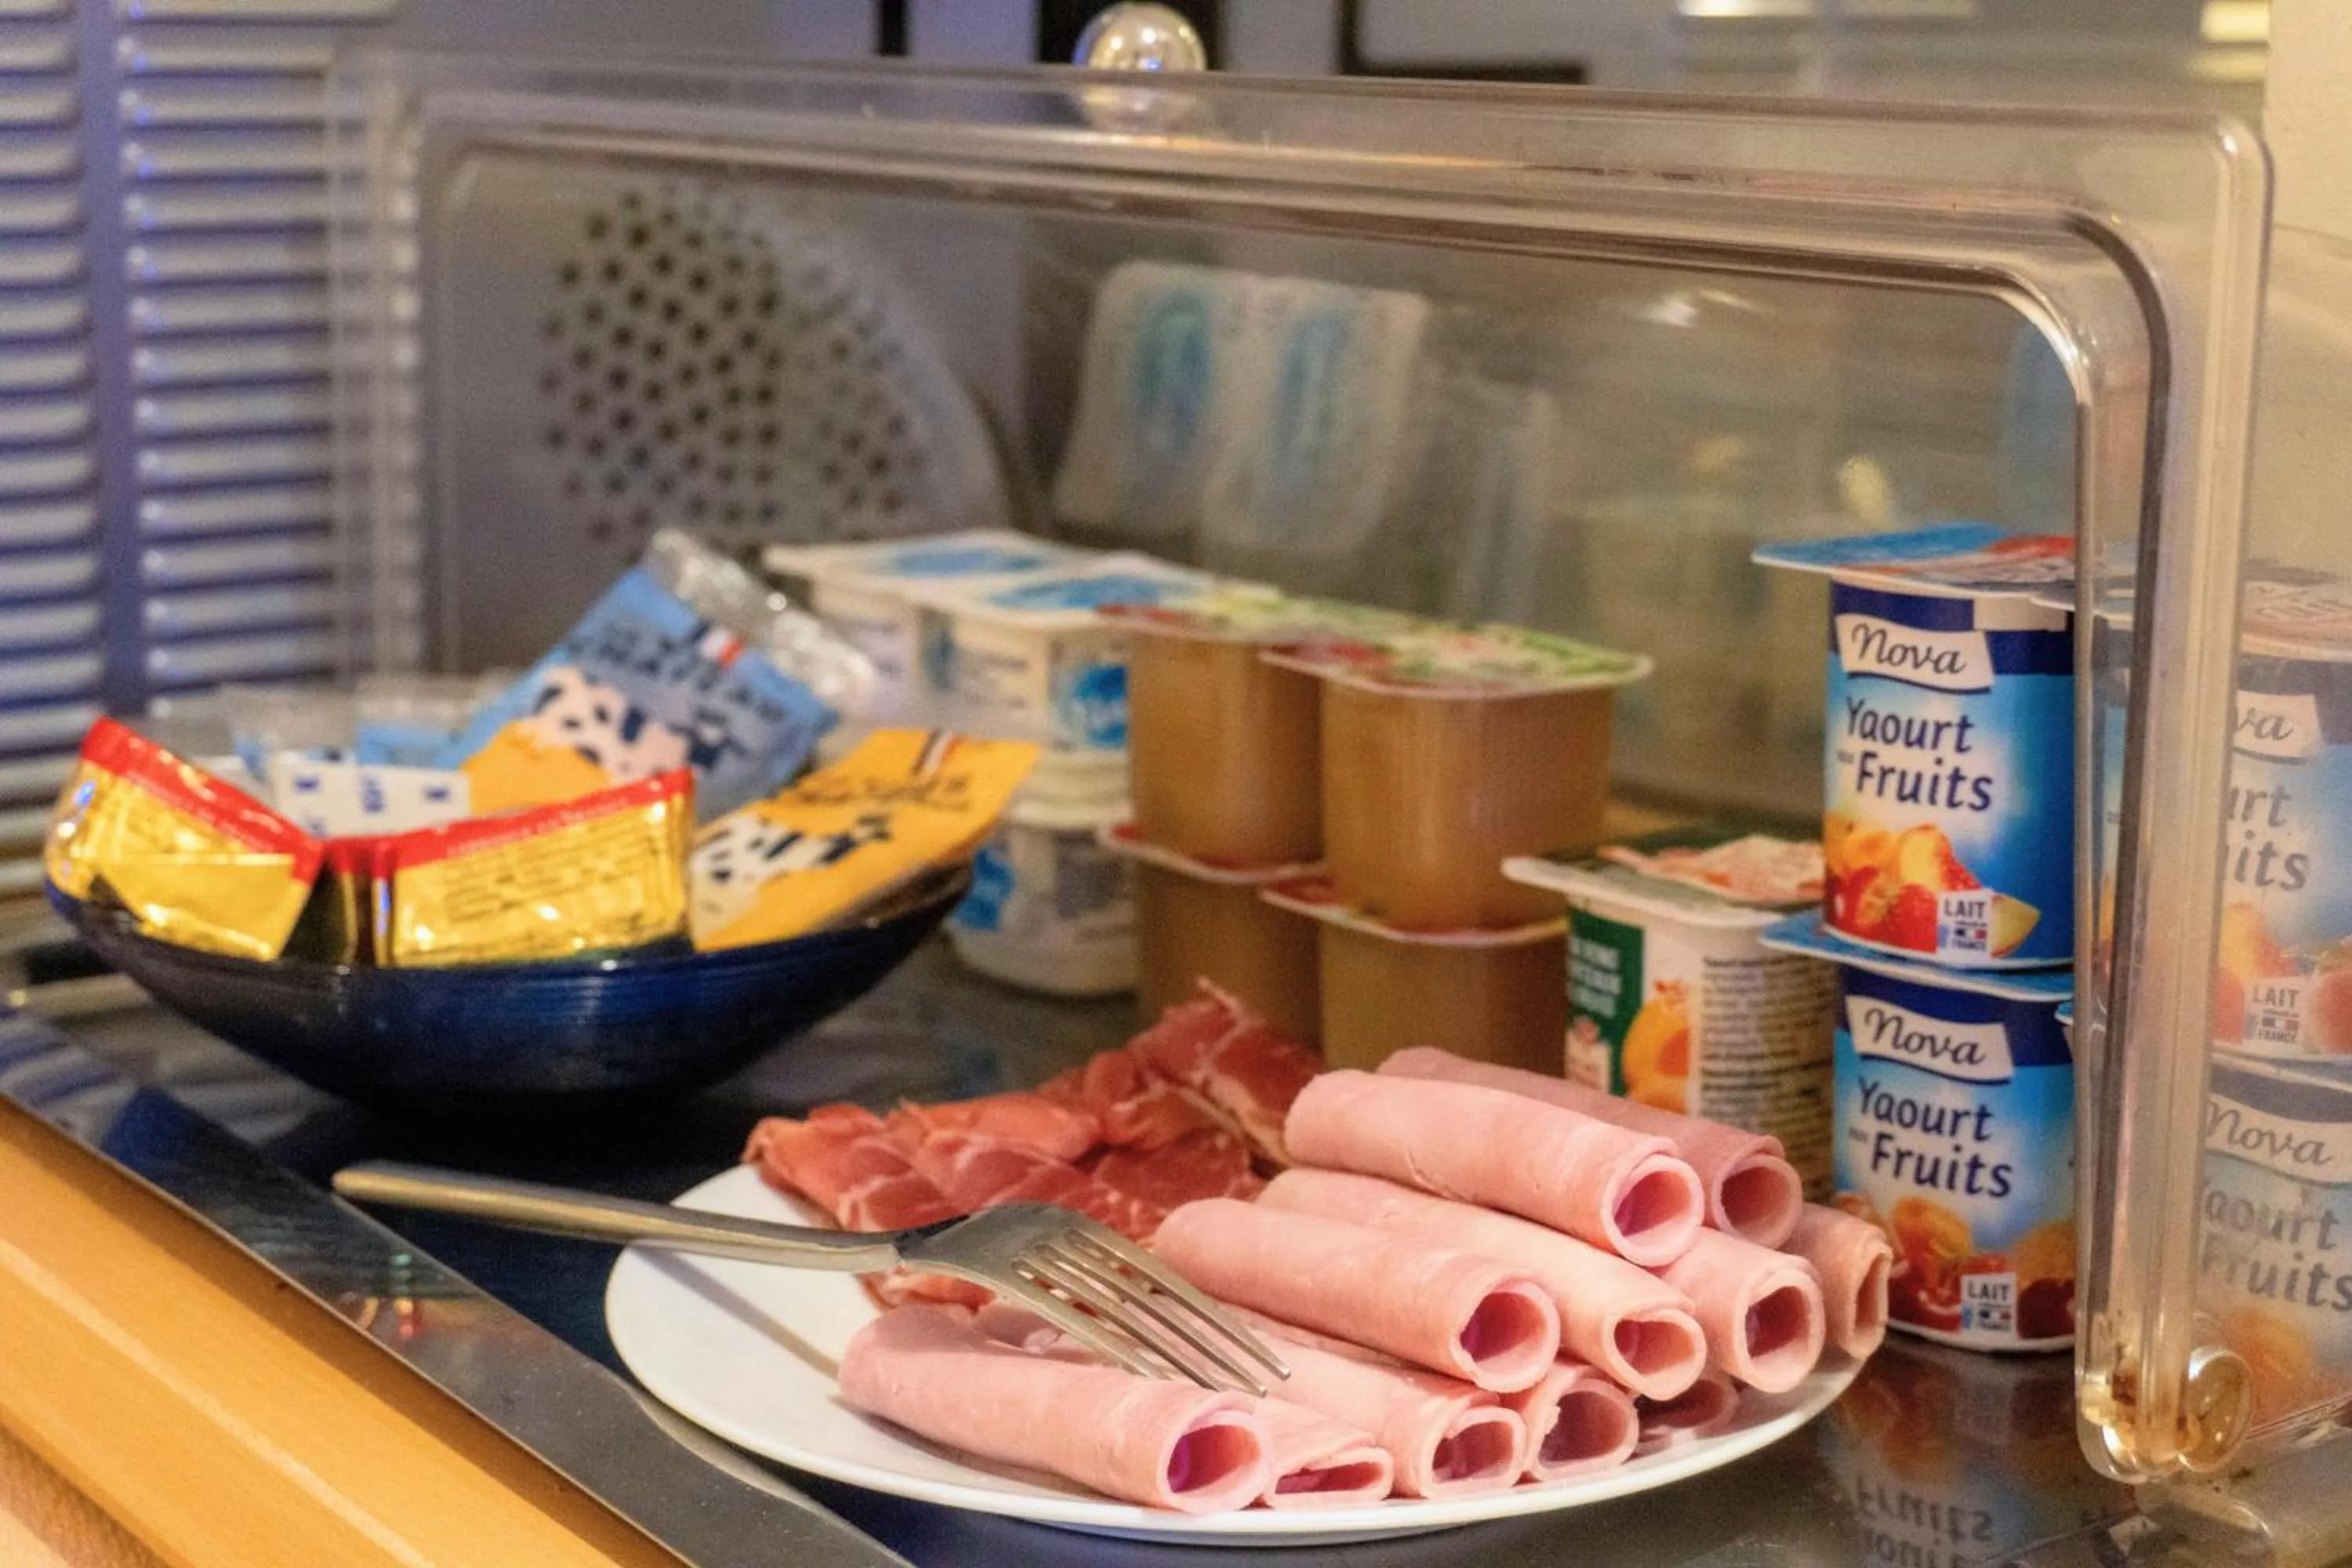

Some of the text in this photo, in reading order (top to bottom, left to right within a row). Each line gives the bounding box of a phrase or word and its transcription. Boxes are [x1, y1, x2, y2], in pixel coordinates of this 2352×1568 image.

[1851, 622, 1968, 675] Nova
[1846, 696, 1975, 753] Yaourt
[1856, 750, 1993, 811] Fruits
[1944, 898, 1986, 920] LAIT
[2252, 984, 2300, 1010] LAIT
[1864, 1007, 1986, 1065] Nova
[1858, 1076, 1994, 1142] Yaourt
[1871, 1132, 2013, 1198] Fruits
[1968, 1279, 2009, 1301] LAIT
